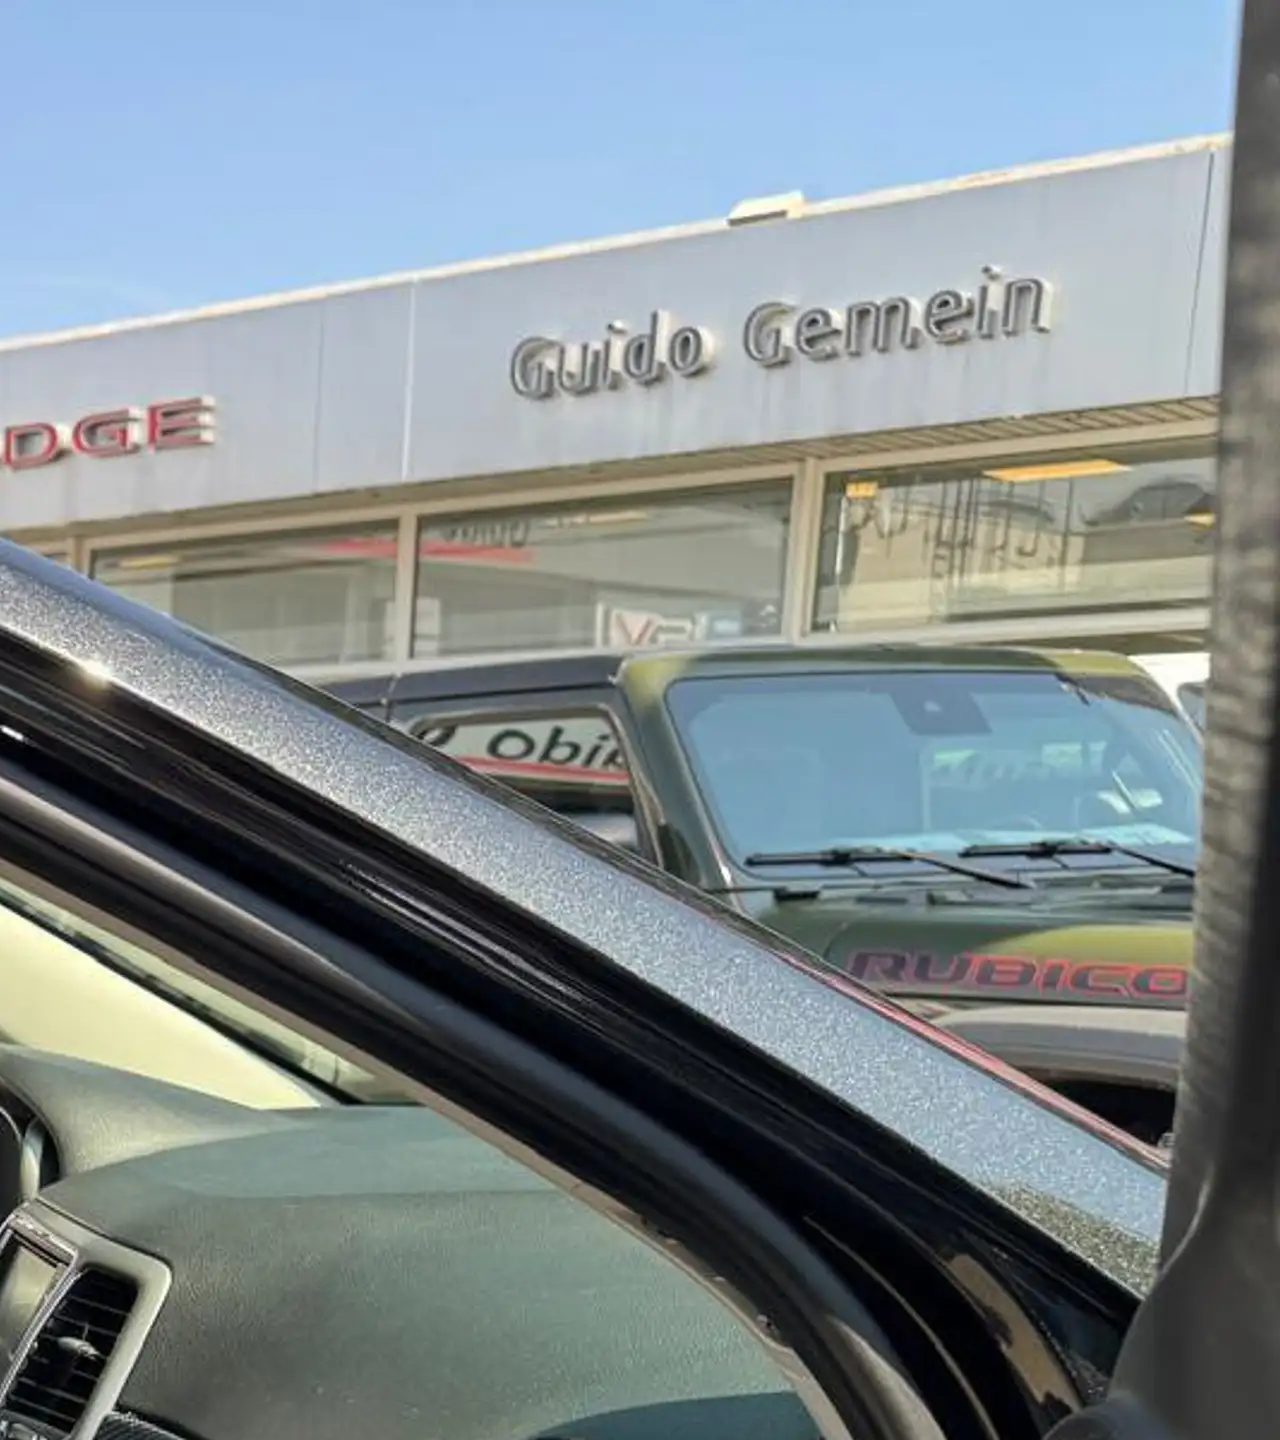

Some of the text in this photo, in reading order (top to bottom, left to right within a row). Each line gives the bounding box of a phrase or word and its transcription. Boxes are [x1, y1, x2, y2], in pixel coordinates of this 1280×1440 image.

[510, 265, 1052, 400] Guido Gemein
[846, 950, 1189, 995] RUBICO
